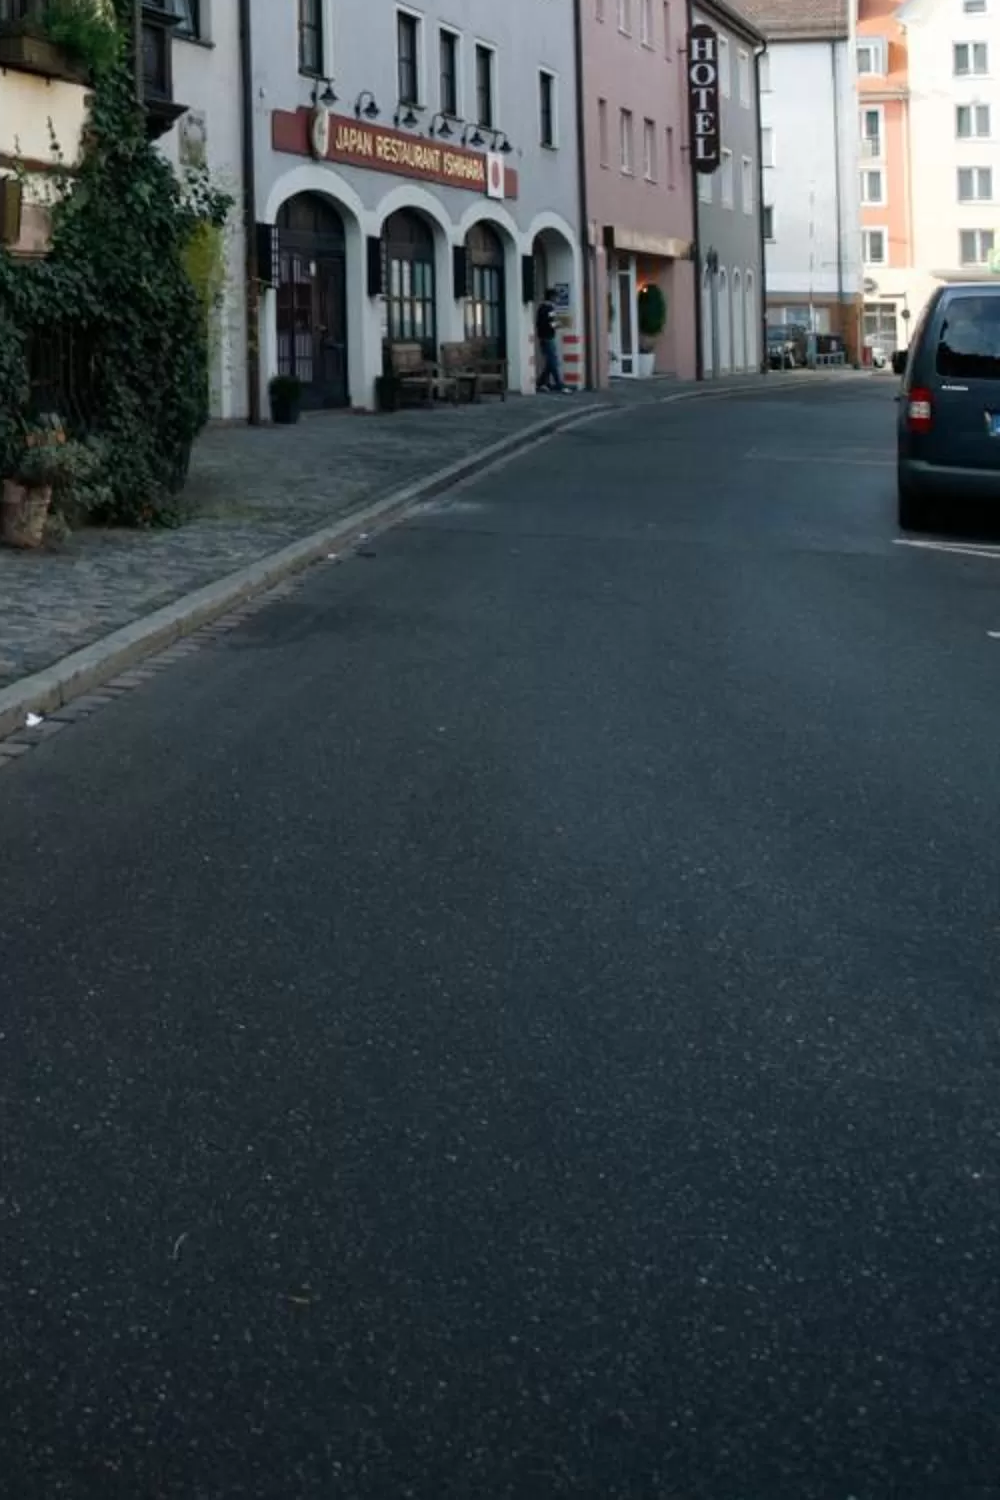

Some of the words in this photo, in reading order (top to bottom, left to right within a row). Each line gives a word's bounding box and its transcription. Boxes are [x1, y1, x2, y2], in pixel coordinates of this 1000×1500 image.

[690, 38, 716, 159] HOTEL
[335, 125, 373, 157] JAPAN
[375, 135, 441, 172] RESTAURANT
